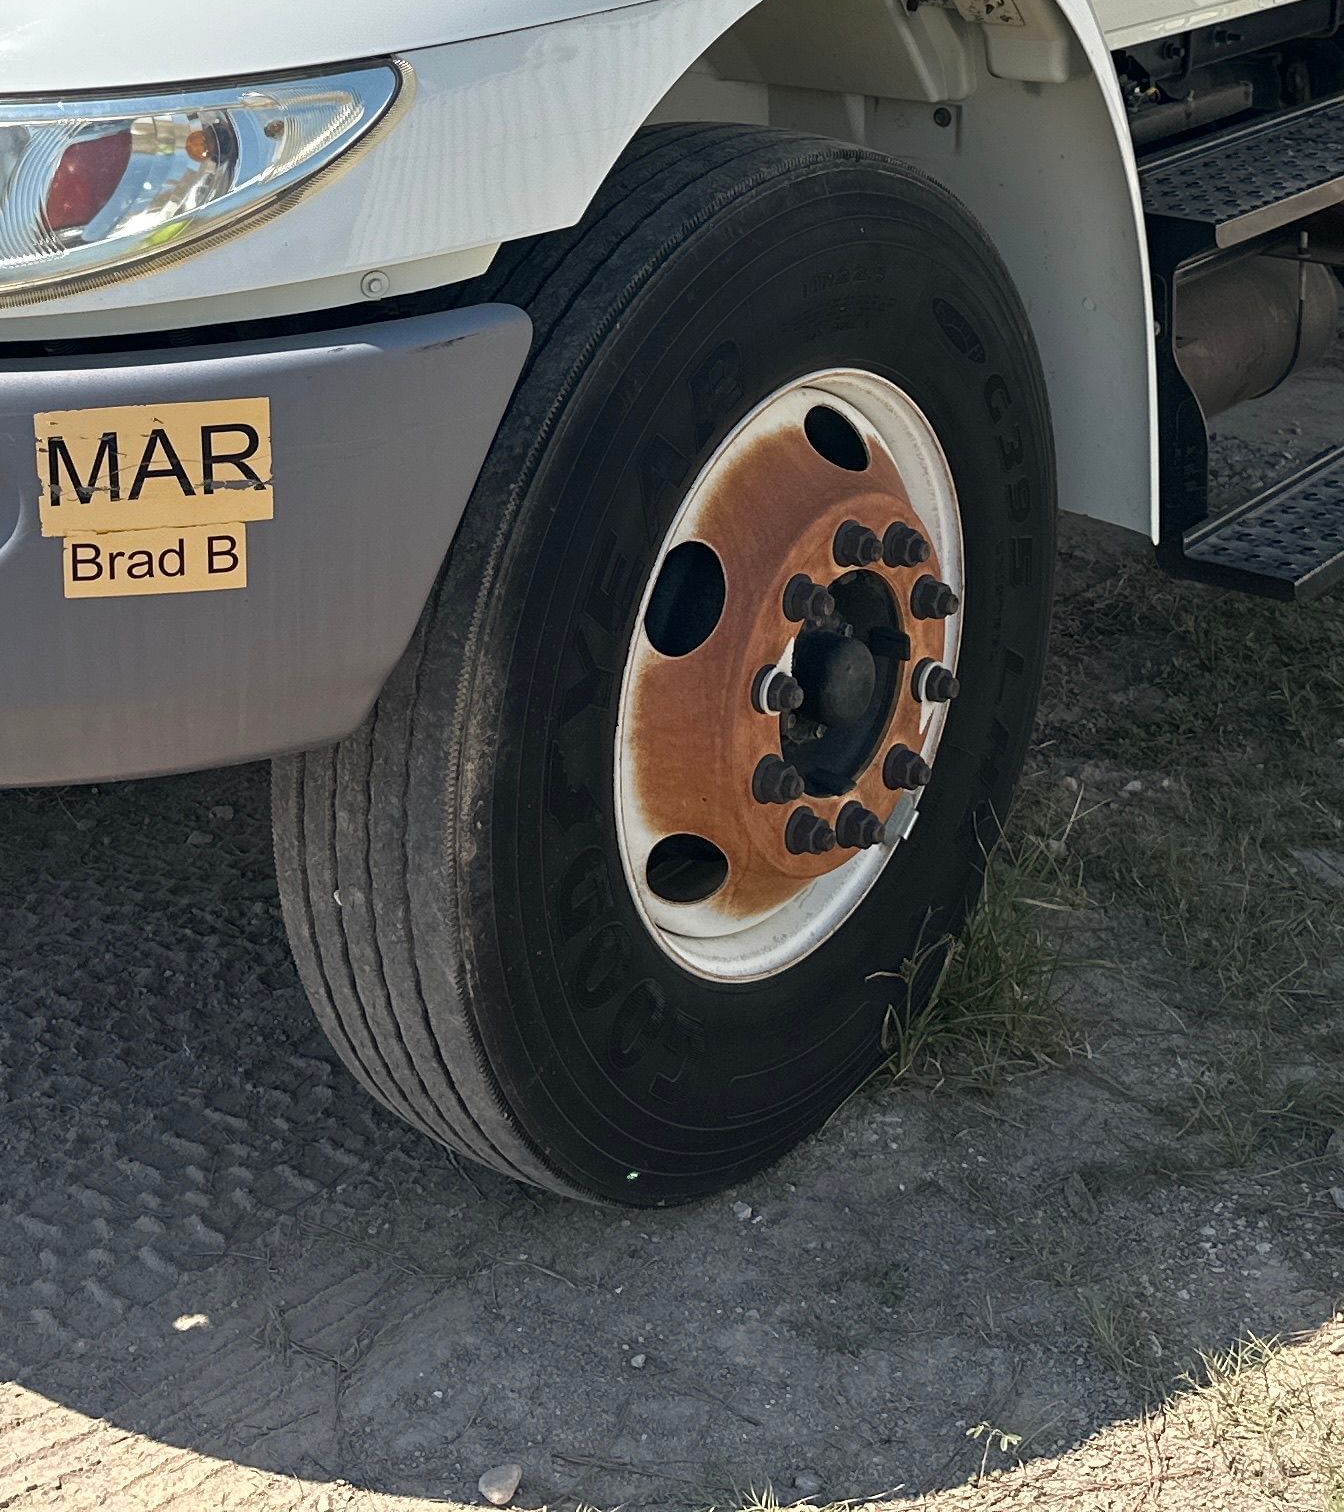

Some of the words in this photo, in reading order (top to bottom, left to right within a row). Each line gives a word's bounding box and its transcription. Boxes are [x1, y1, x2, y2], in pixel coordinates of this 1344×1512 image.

[47, 423, 267, 507] MAR
[982, 372, 1034, 590] G395
[71, 538, 186, 582] Brad
[207, 534, 240, 575] B
